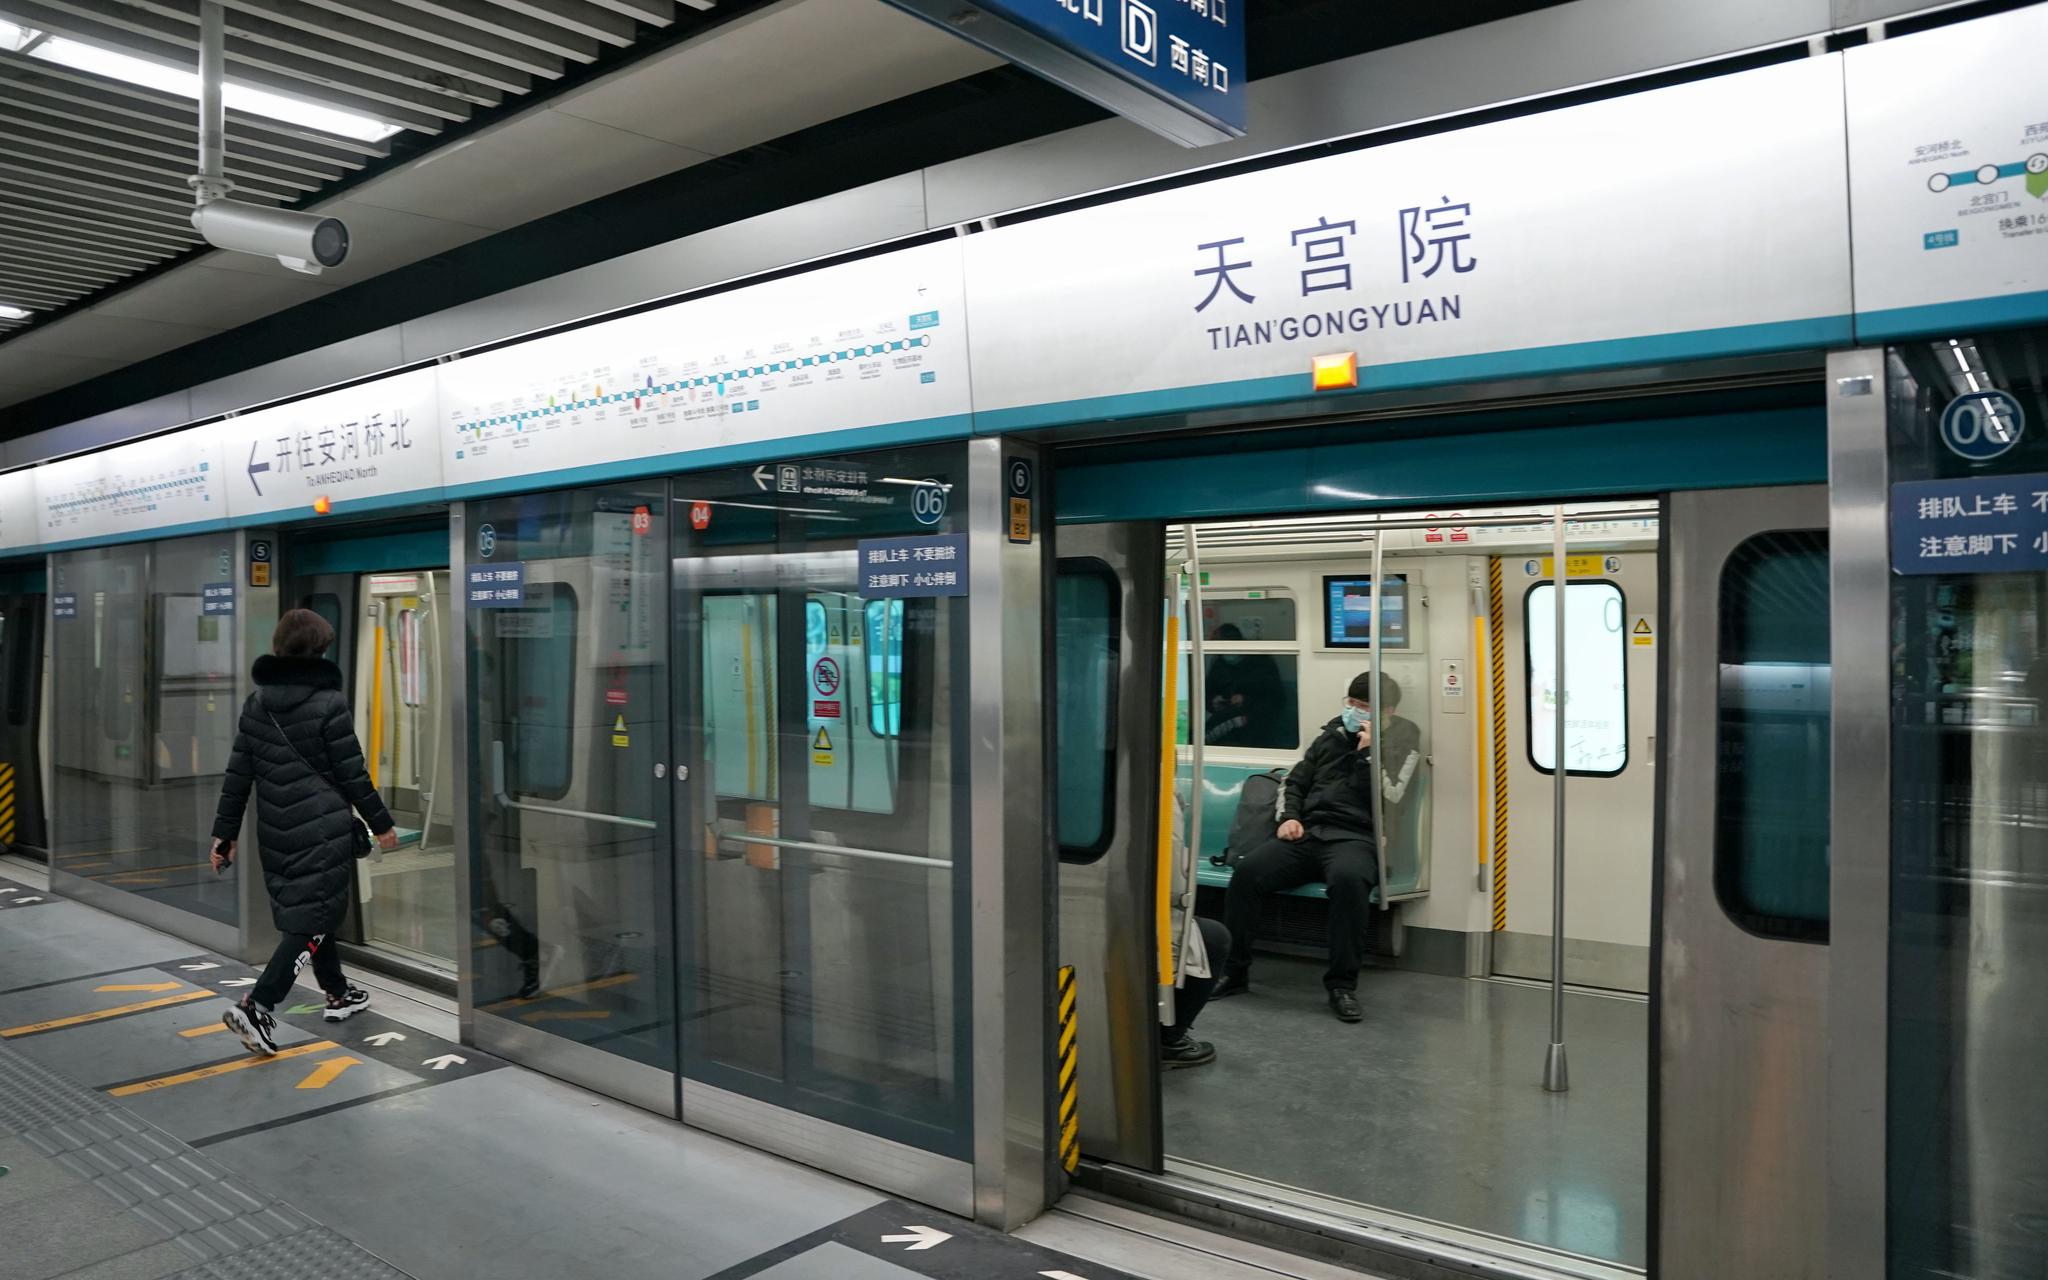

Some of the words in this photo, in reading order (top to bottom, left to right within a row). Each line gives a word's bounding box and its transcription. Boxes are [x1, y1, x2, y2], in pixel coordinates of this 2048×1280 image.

[1129, 5, 1152, 54] D
[1169, 34, 1228, 95] 西南口
[1914, 139, 1963, 157] 安河桥北
[1970, 191, 2009, 207] 北宫门
[1194, 195, 1477, 313] 天宫院
[1207, 294, 1461, 350] TIAN'GONGYUAN
[1951, 400, 2014, 444] 06
[276, 409, 412, 472] 开往安河桥北
[356, 466, 378, 478] North
[1016, 469, 1025, 487] 6
[915, 488, 942, 514] 06
[1918, 492, 2018, 519] 排队上车
[634, 514, 649, 528] 03
[692, 508, 709, 524] 04
[480, 531, 494, 550] 05
[1919, 533, 2018, 558] 注意脚下
[256, 546, 266, 557] 5
[868, 549, 909, 564] 排队上车
[913, 546, 956, 561] 不要拥挤
[868, 574, 909, 588] 注意脚下
[914, 572, 956, 587] 小心摔倒
